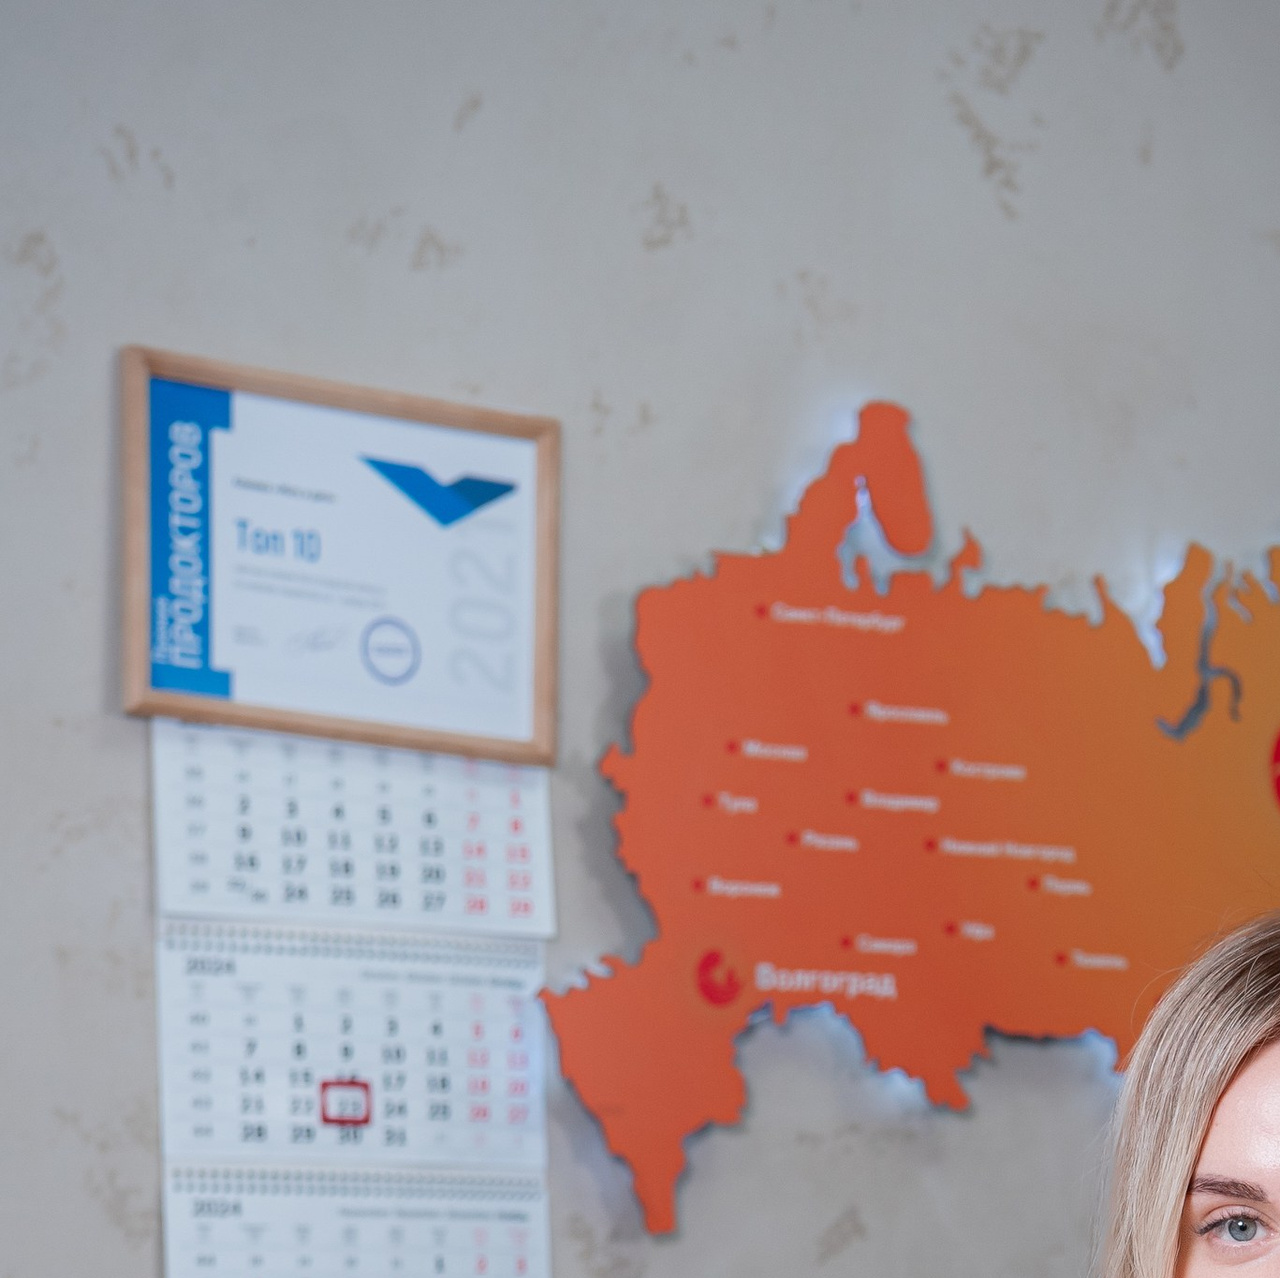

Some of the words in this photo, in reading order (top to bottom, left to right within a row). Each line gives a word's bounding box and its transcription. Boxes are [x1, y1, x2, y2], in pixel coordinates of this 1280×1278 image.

[169, 421, 208, 668] ПРОДОКТОРОВ
[234, 518, 284, 558] Топ
[292, 526, 322, 563] 10
[755, 962, 897, 1000] Волгоград
